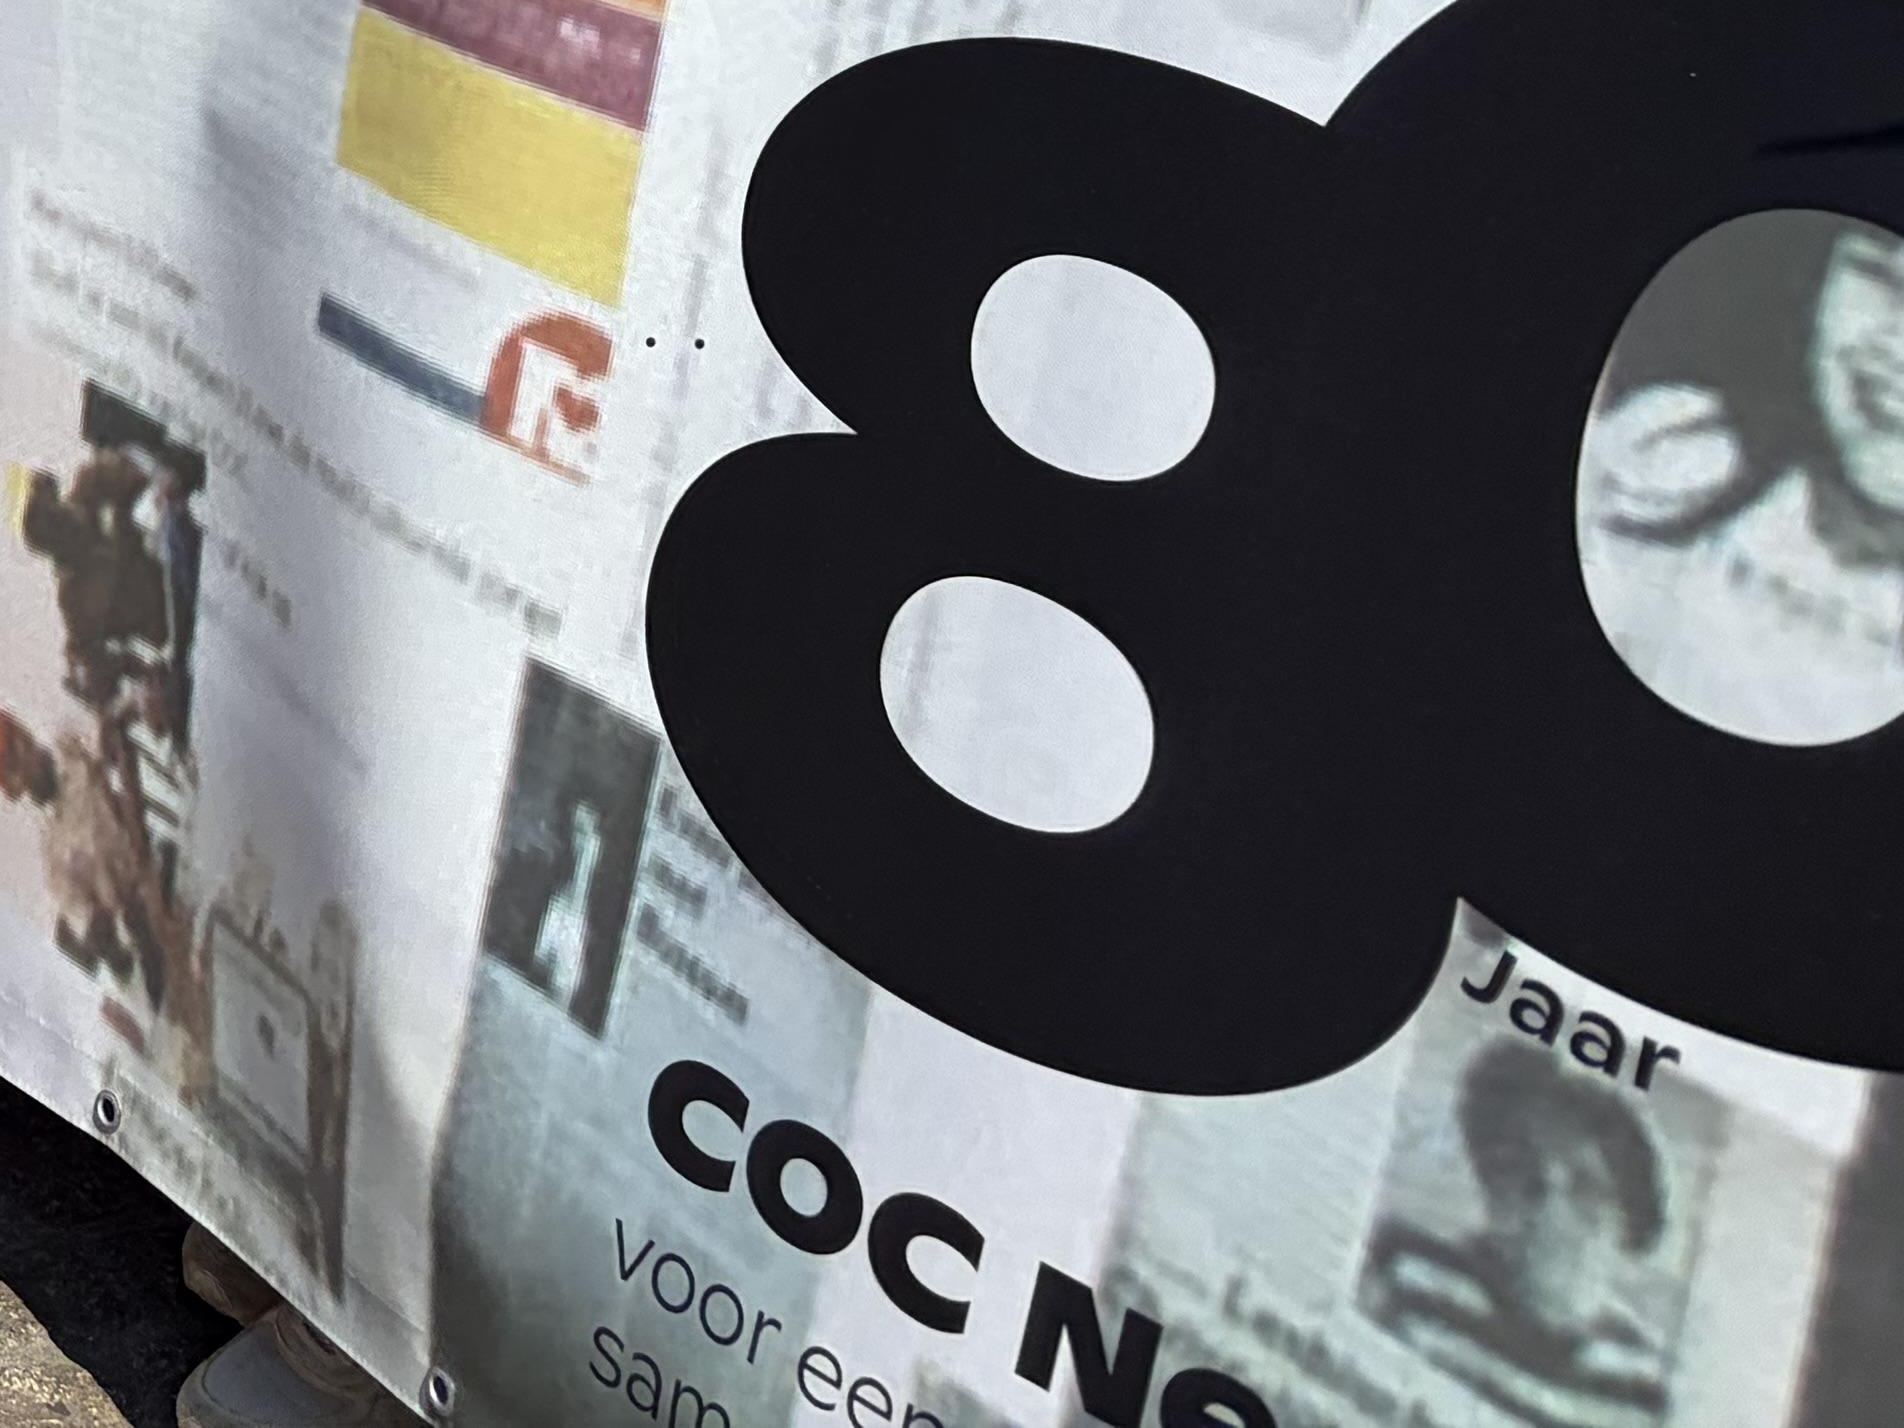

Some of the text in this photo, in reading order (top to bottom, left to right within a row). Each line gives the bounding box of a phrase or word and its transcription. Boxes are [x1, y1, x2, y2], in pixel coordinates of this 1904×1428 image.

[1459, 948, 1682, 1092] Jaar
[647, 1058, 986, 1335] COC
[615, 1218, 784, 1365] voor
[588, 1325, 732, 1428] sam
